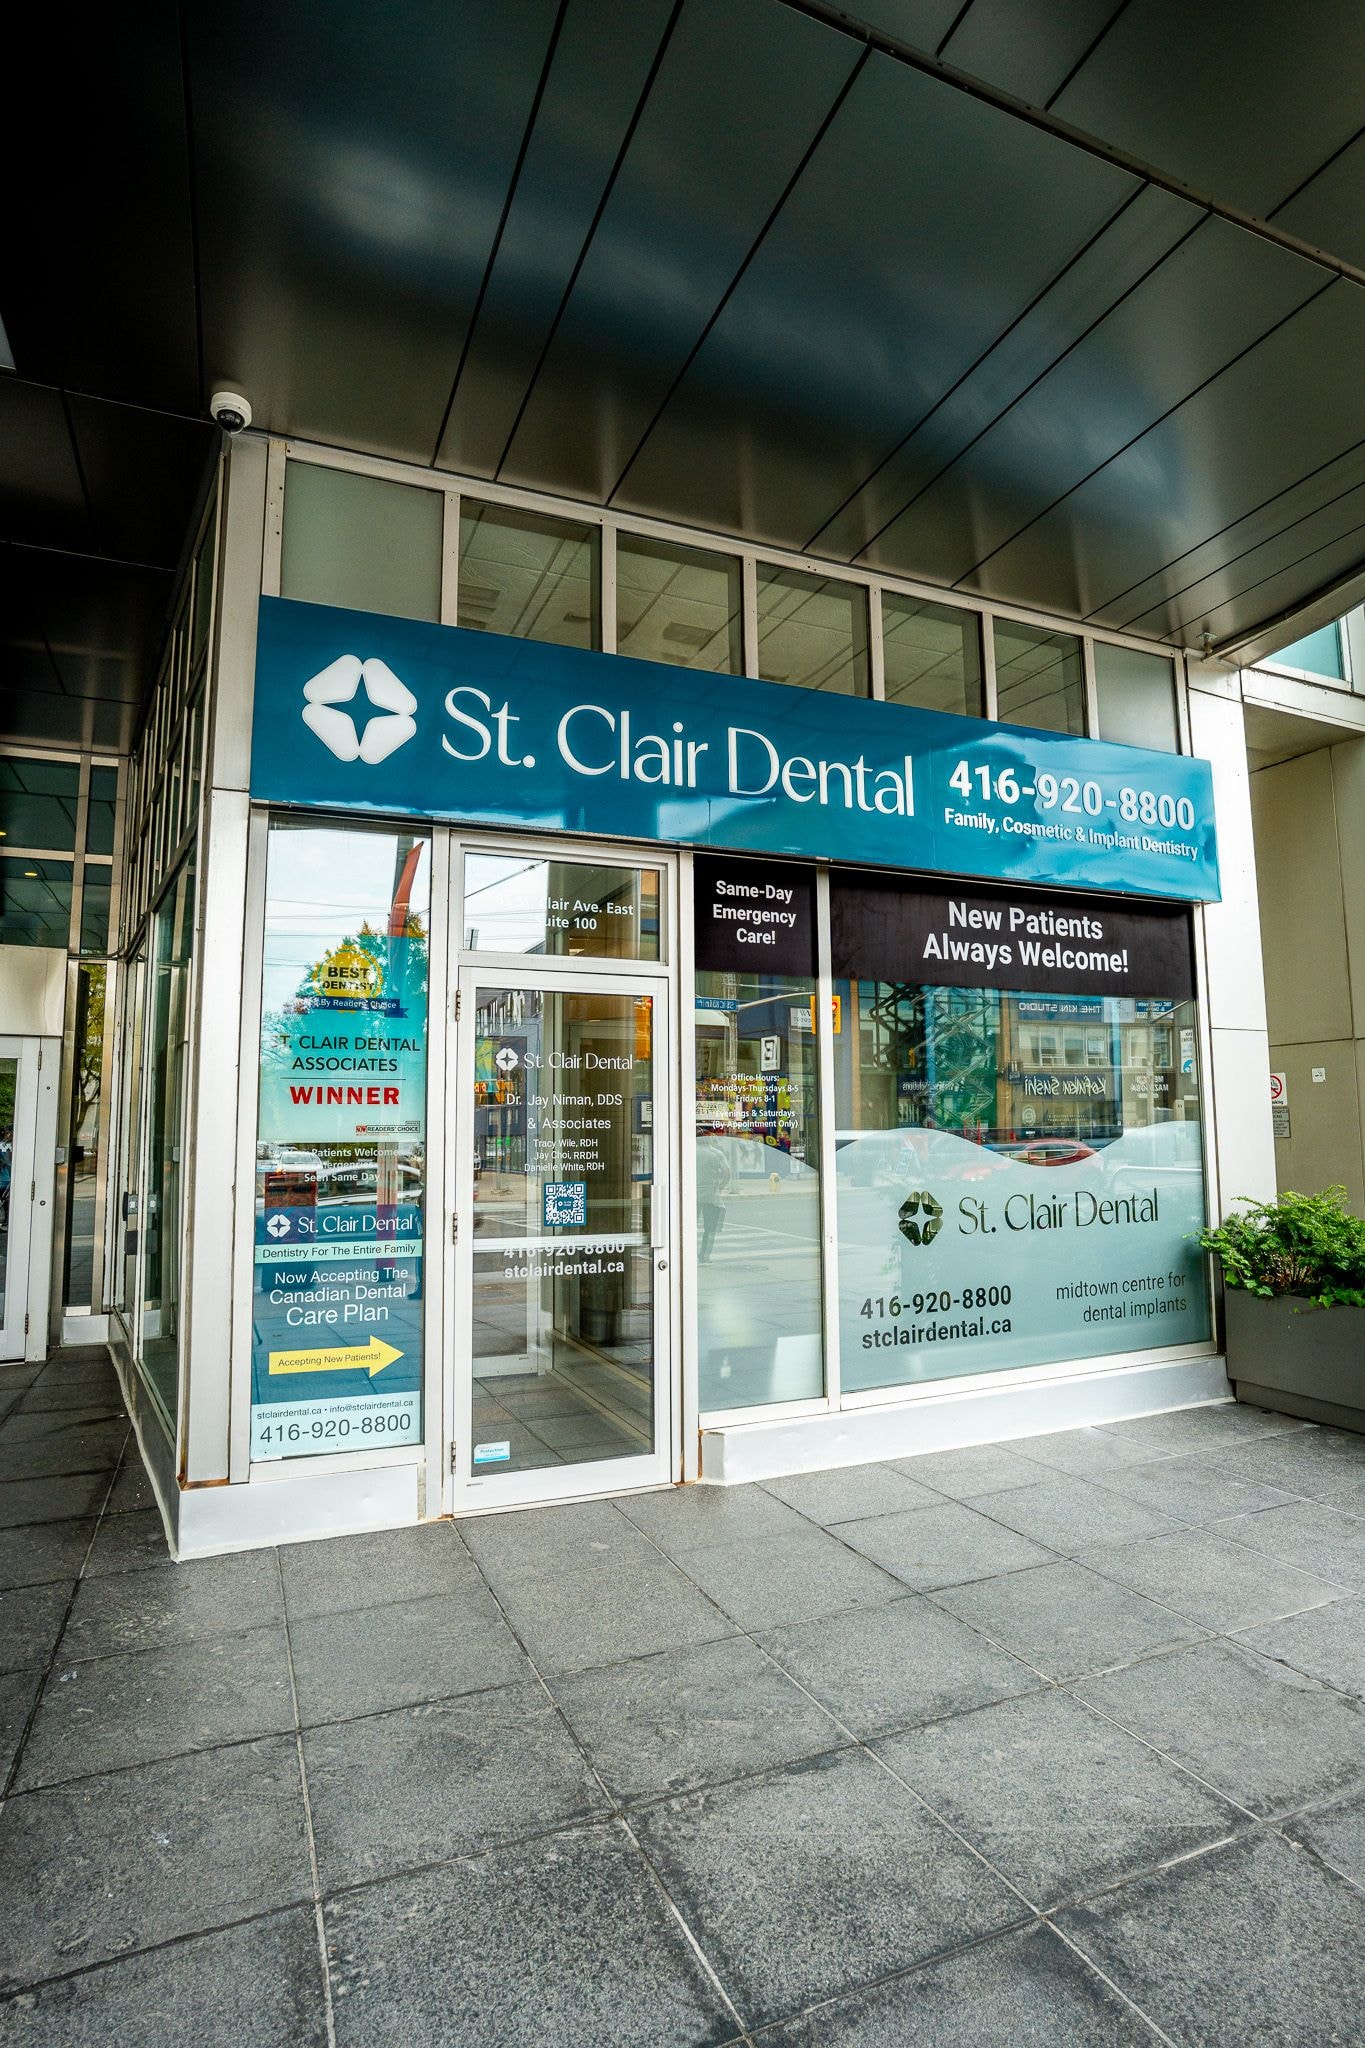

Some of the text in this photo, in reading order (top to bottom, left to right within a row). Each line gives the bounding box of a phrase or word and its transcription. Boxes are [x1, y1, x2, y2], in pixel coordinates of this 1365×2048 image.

[442, 686, 915, 817] St. Clair Dental
[949, 760, 1195, 830] 416-920-8800
[944, 807, 1198, 861] Family, Cosmetic & Implant Dentistry
[715, 880, 793, 904] Same-Day
[540, 896, 570, 911] lair
[573, 900, 602, 913] Ave.
[606, 902, 634, 915] East
[540, 915, 597, 930] uite 100
[712, 904, 796, 927] Emergency
[948, 901, 1103, 939] New Patients
[736, 928, 776, 944] Care!
[922, 933, 1129, 973] Always Welcome!
[328, 967, 369, 979] BEST
[299, 1035, 348, 1050] CLAIR
[355, 1037, 420, 1051] DENTAL
[292, 1057, 398, 1072] ASSOCIATES
[524, 1051, 633, 1070] St. Clair Dental
[730, 1073, 754, 1081] Office
[289, 1086, 400, 1105] WINNER
[787, 1084, 799, 1092] 8-5
[506, 1093, 622, 1108] Dr. Jay Niman, DDS
[736, 1095, 762, 1104] Fridays
[527, 1117, 611, 1129] & Associates
[759, 1109, 795, 1118] Saturdays
[778, 1120, 799, 1128] Only)
[312, 1148, 351, 1157] Patients
[533, 1139, 556, 1149] Tracy
[580, 1138, 598, 1147] RDH
[534, 1151, 549, 1161] Jay
[573, 1151, 599, 1160] RRDH
[524, 1162, 557, 1172] Danielle
[586, 1162, 605, 1171] RDH
[332, 1173, 358, 1182] Same
[361, 1172, 381, 1183] Day
[957, 1187, 1159, 1235] St. Clair Dental
[297, 1213, 413, 1234] St. Clair Dental
[262, 1243, 416, 1259] Dentistry For The Entire Family
[275, 1267, 408, 1285] Now Accepting The
[504, 1259, 625, 1278] stclairdental.ca
[269, 1283, 406, 1304] Canadian Dental
[1056, 1272, 1187, 1300] midtown centre for
[860, 1284, 1012, 1320] 416-920-8800
[1082, 1298, 1187, 1323] dental implants
[286, 1303, 389, 1326] Care Plan
[862, 1316, 1012, 1349] stclairdental.ca
[278, 1352, 381, 1367] Accepting New Patients!
[256, 1399, 414, 1420] stclairdental.ca info@stclairdental.ca
[260, 1413, 411, 1443] 416-920-8800
